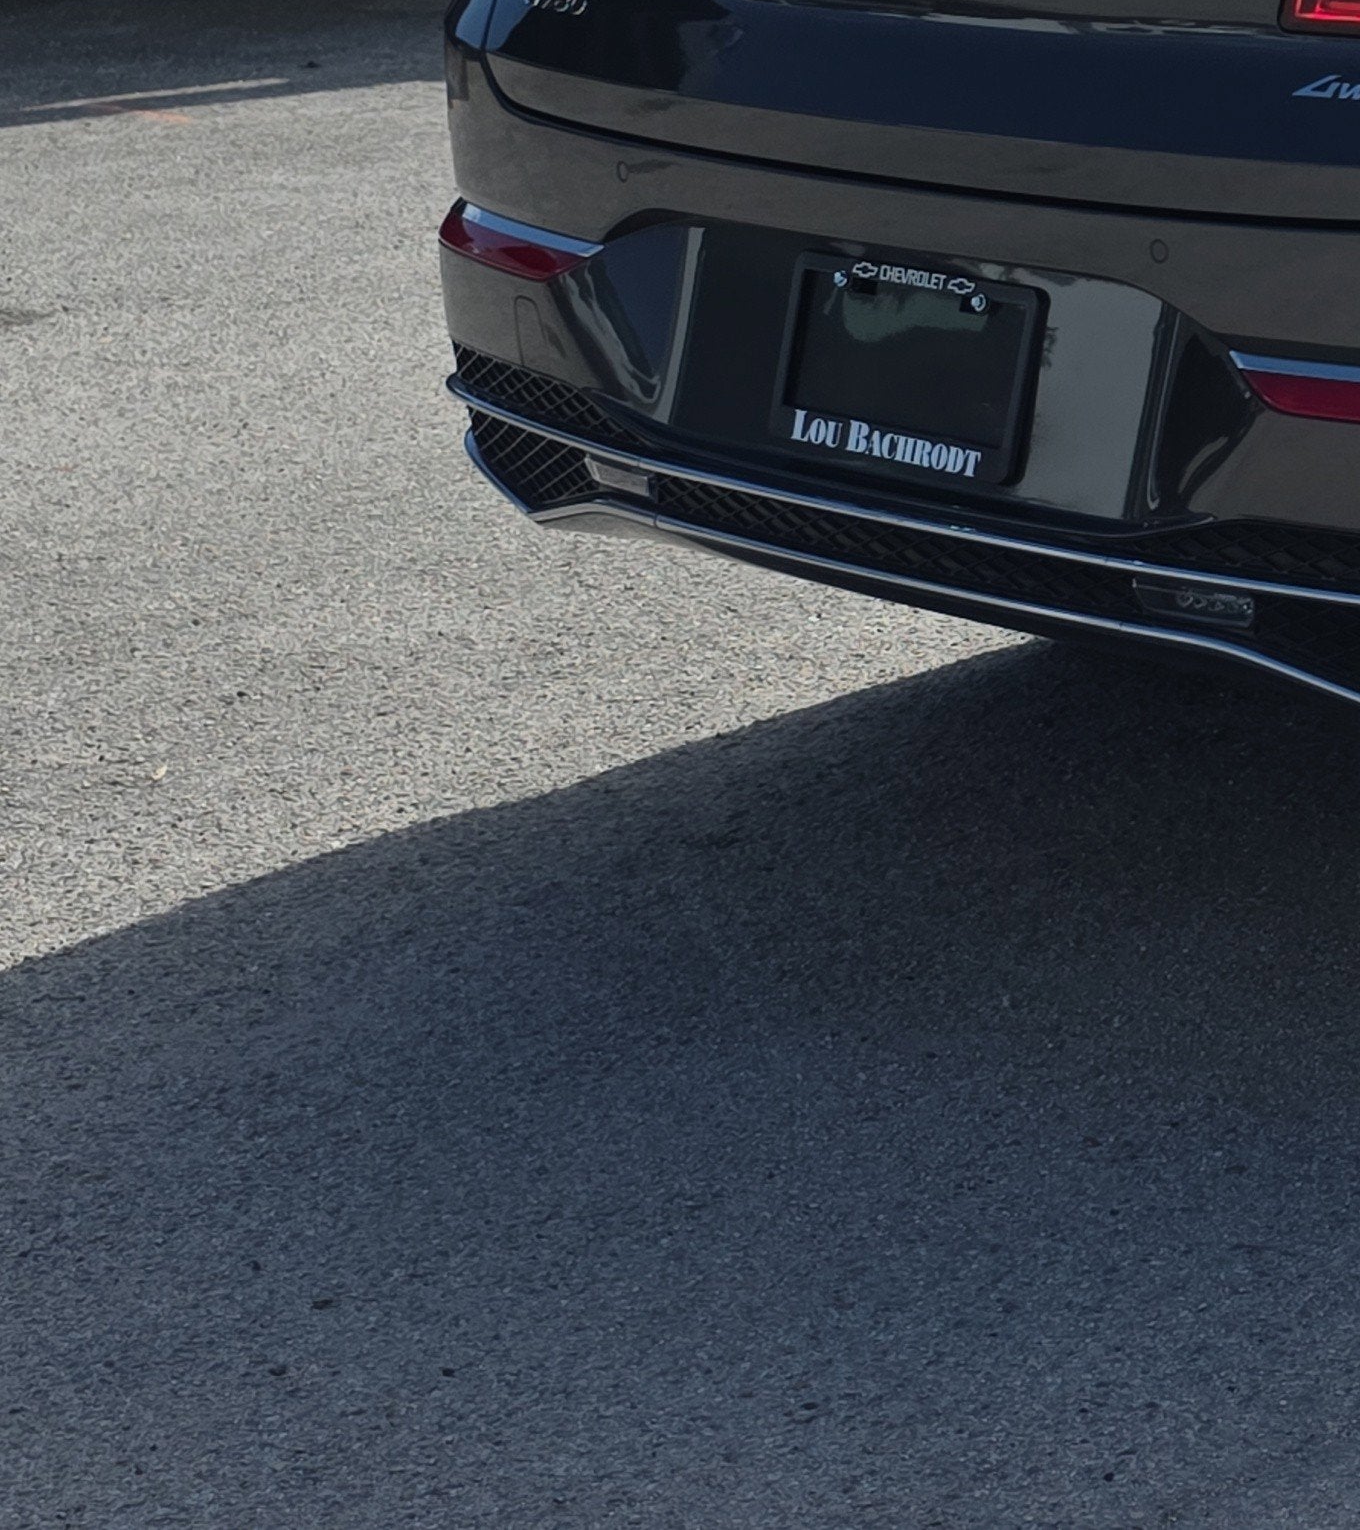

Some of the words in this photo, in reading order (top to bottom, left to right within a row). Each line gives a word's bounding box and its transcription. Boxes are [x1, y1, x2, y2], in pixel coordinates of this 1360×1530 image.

[879, 265, 947, 290] CHEVROLET
[790, 409, 843, 448] LOU
[846, 419, 981, 477] BACHRODT
